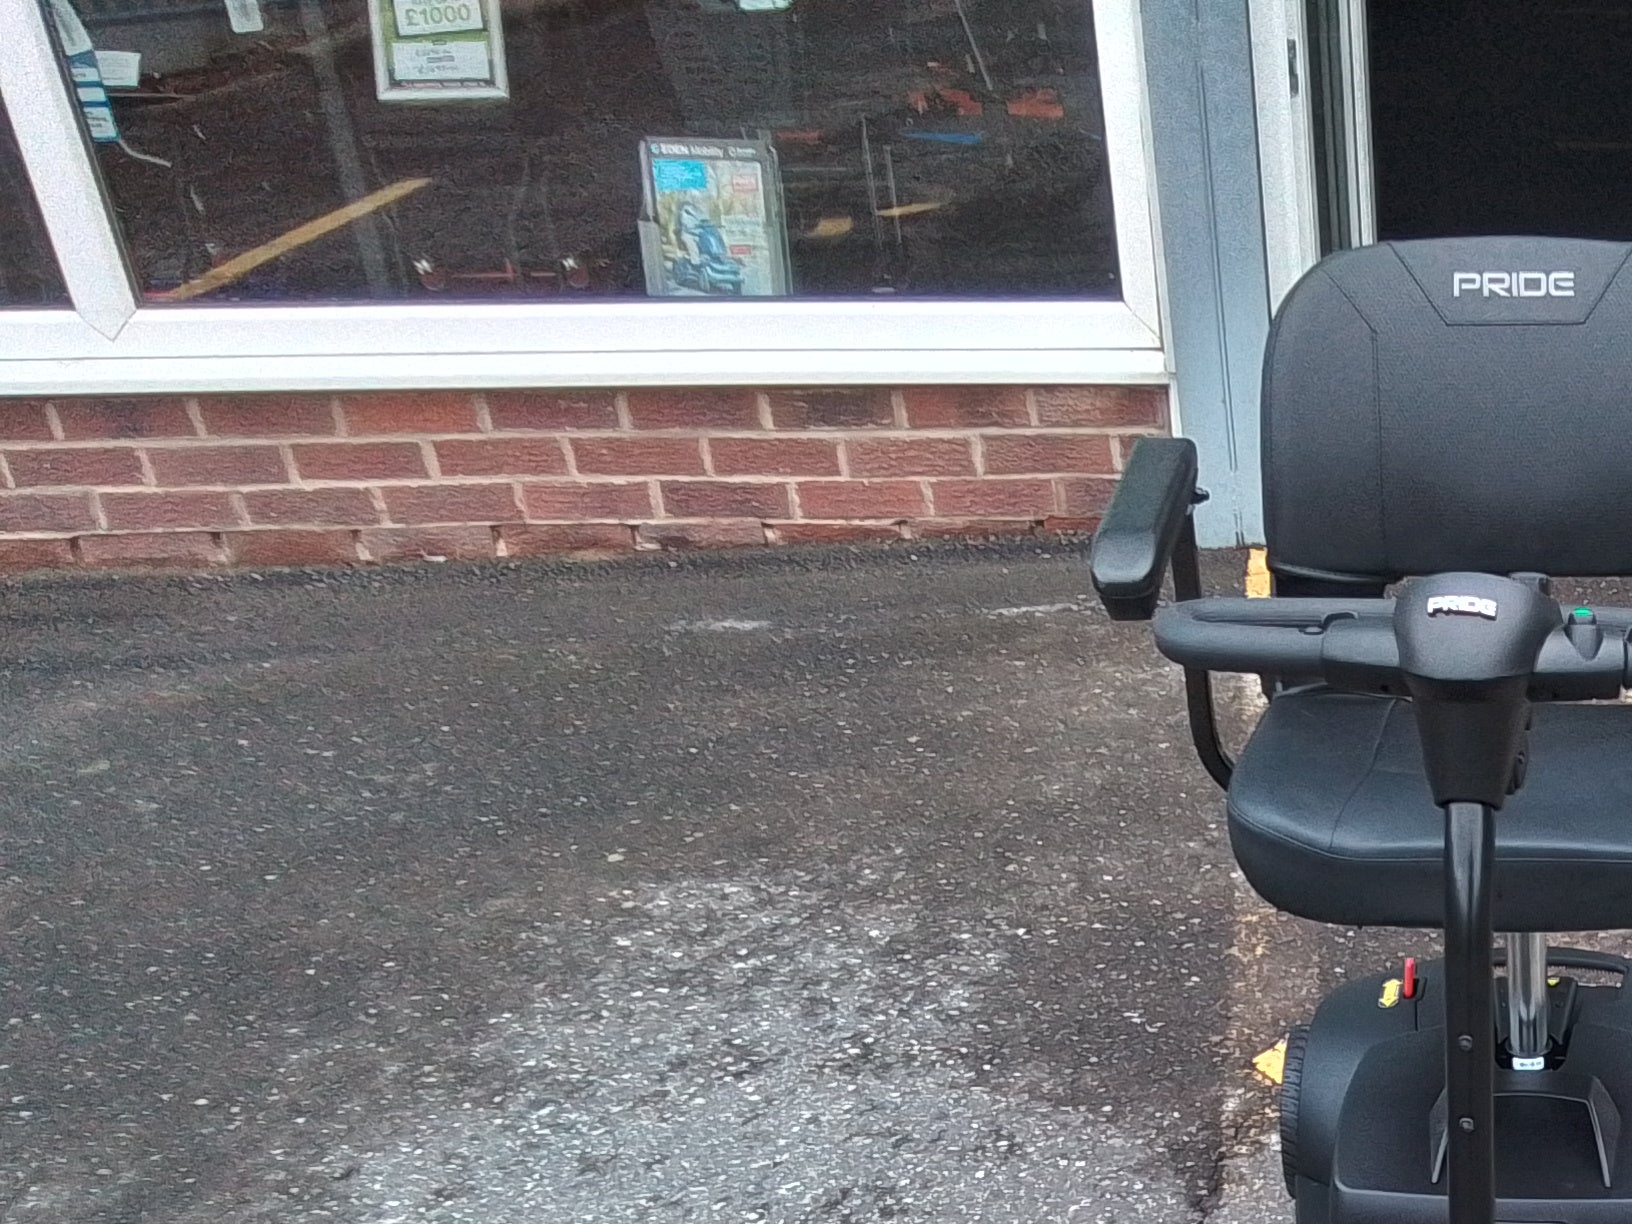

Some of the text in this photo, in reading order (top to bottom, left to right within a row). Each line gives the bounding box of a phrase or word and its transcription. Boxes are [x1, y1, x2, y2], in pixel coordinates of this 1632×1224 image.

[405, 3, 471, 26] £1000
[1453, 271, 1575, 297] PRIDE
[1427, 595, 1497, 618] PRIDE
